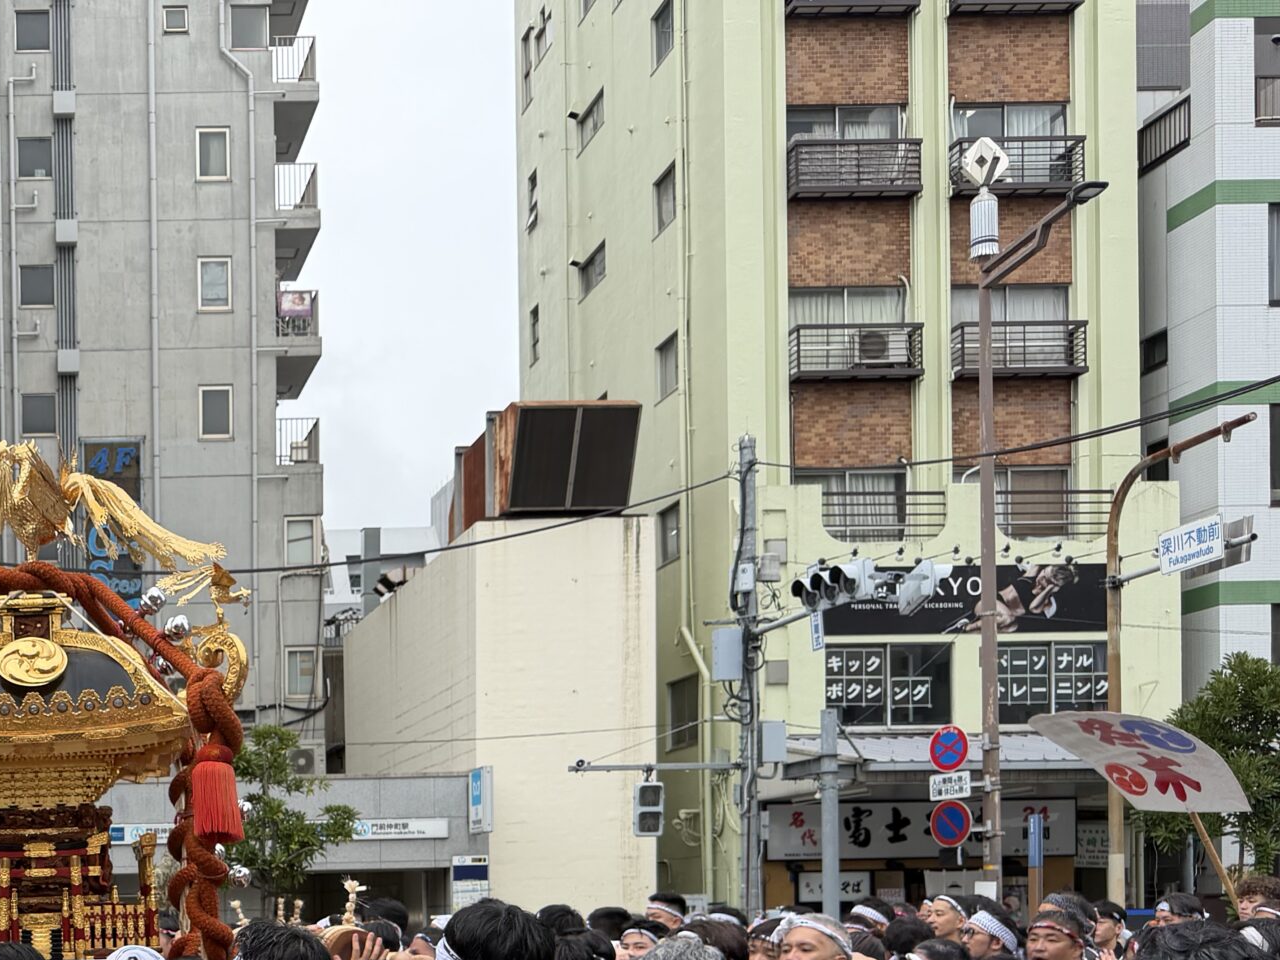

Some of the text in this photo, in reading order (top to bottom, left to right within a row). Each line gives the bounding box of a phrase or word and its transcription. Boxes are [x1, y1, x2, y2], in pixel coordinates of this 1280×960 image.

[89, 448, 136, 473] 4F
[1161, 521, 1220, 556] 深川不動前
[1168, 545, 1213, 567] Fukagawafudo
[827, 655, 881, 672] キック
[826, 683, 929, 701] ボクシング
